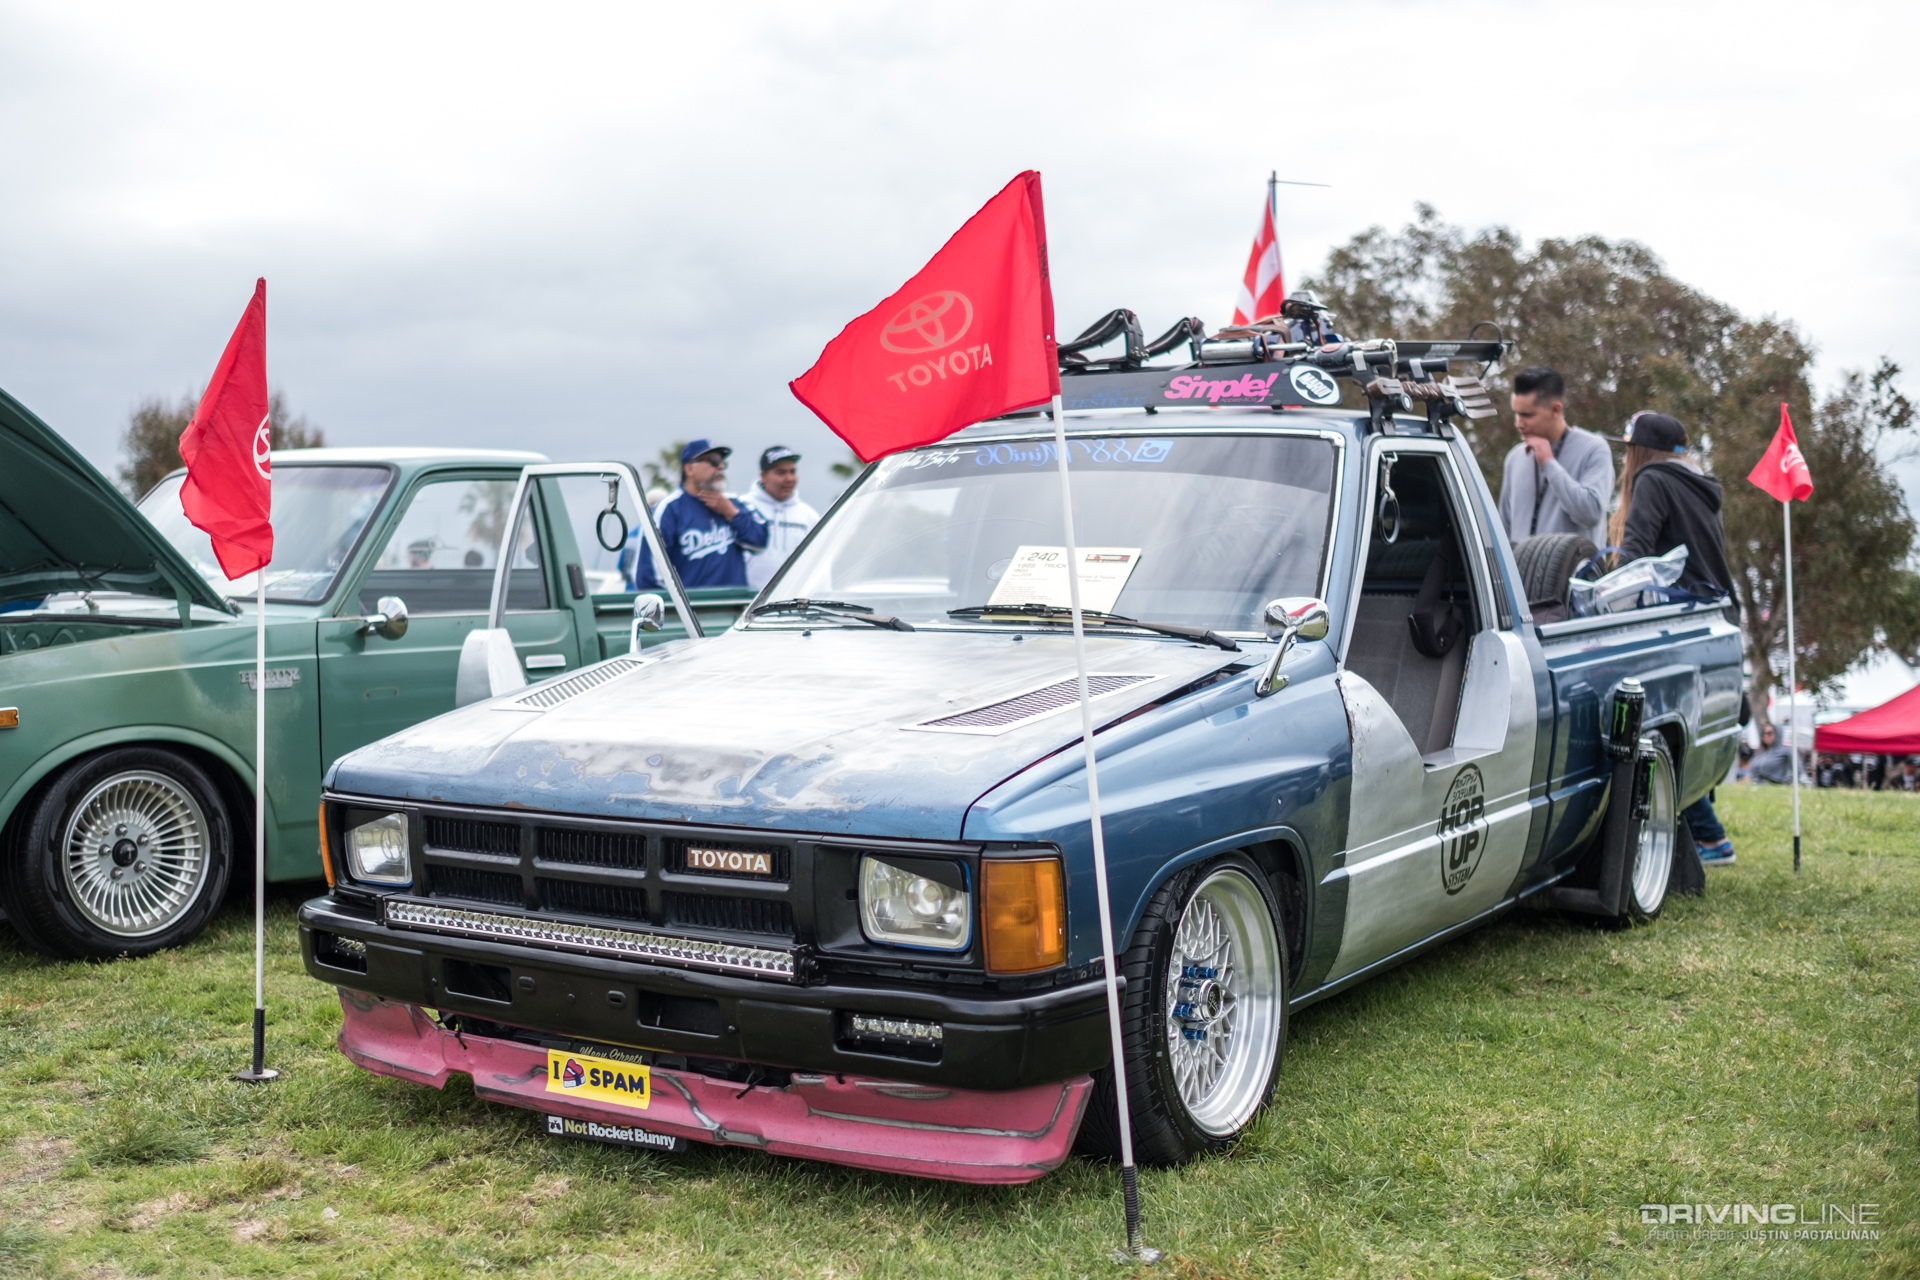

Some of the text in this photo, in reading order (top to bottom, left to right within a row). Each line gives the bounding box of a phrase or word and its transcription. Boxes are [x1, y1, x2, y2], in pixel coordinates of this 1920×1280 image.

[887, 343, 993, 392] TOYOTA
[1027, 552, 1059, 562] 240
[239, 667, 300, 684] HLUX
[1440, 795, 1484, 837] HOP
[691, 849, 767, 872] TOYOTA
[1449, 830, 1479, 870] UP
[1447, 866, 1471, 889] SYSTEM
[609, 1049, 643, 1064] Streets
[553, 1061, 645, 1095] I SPAM
[564, 1119, 676, 1150] Not Rocket Bunny
